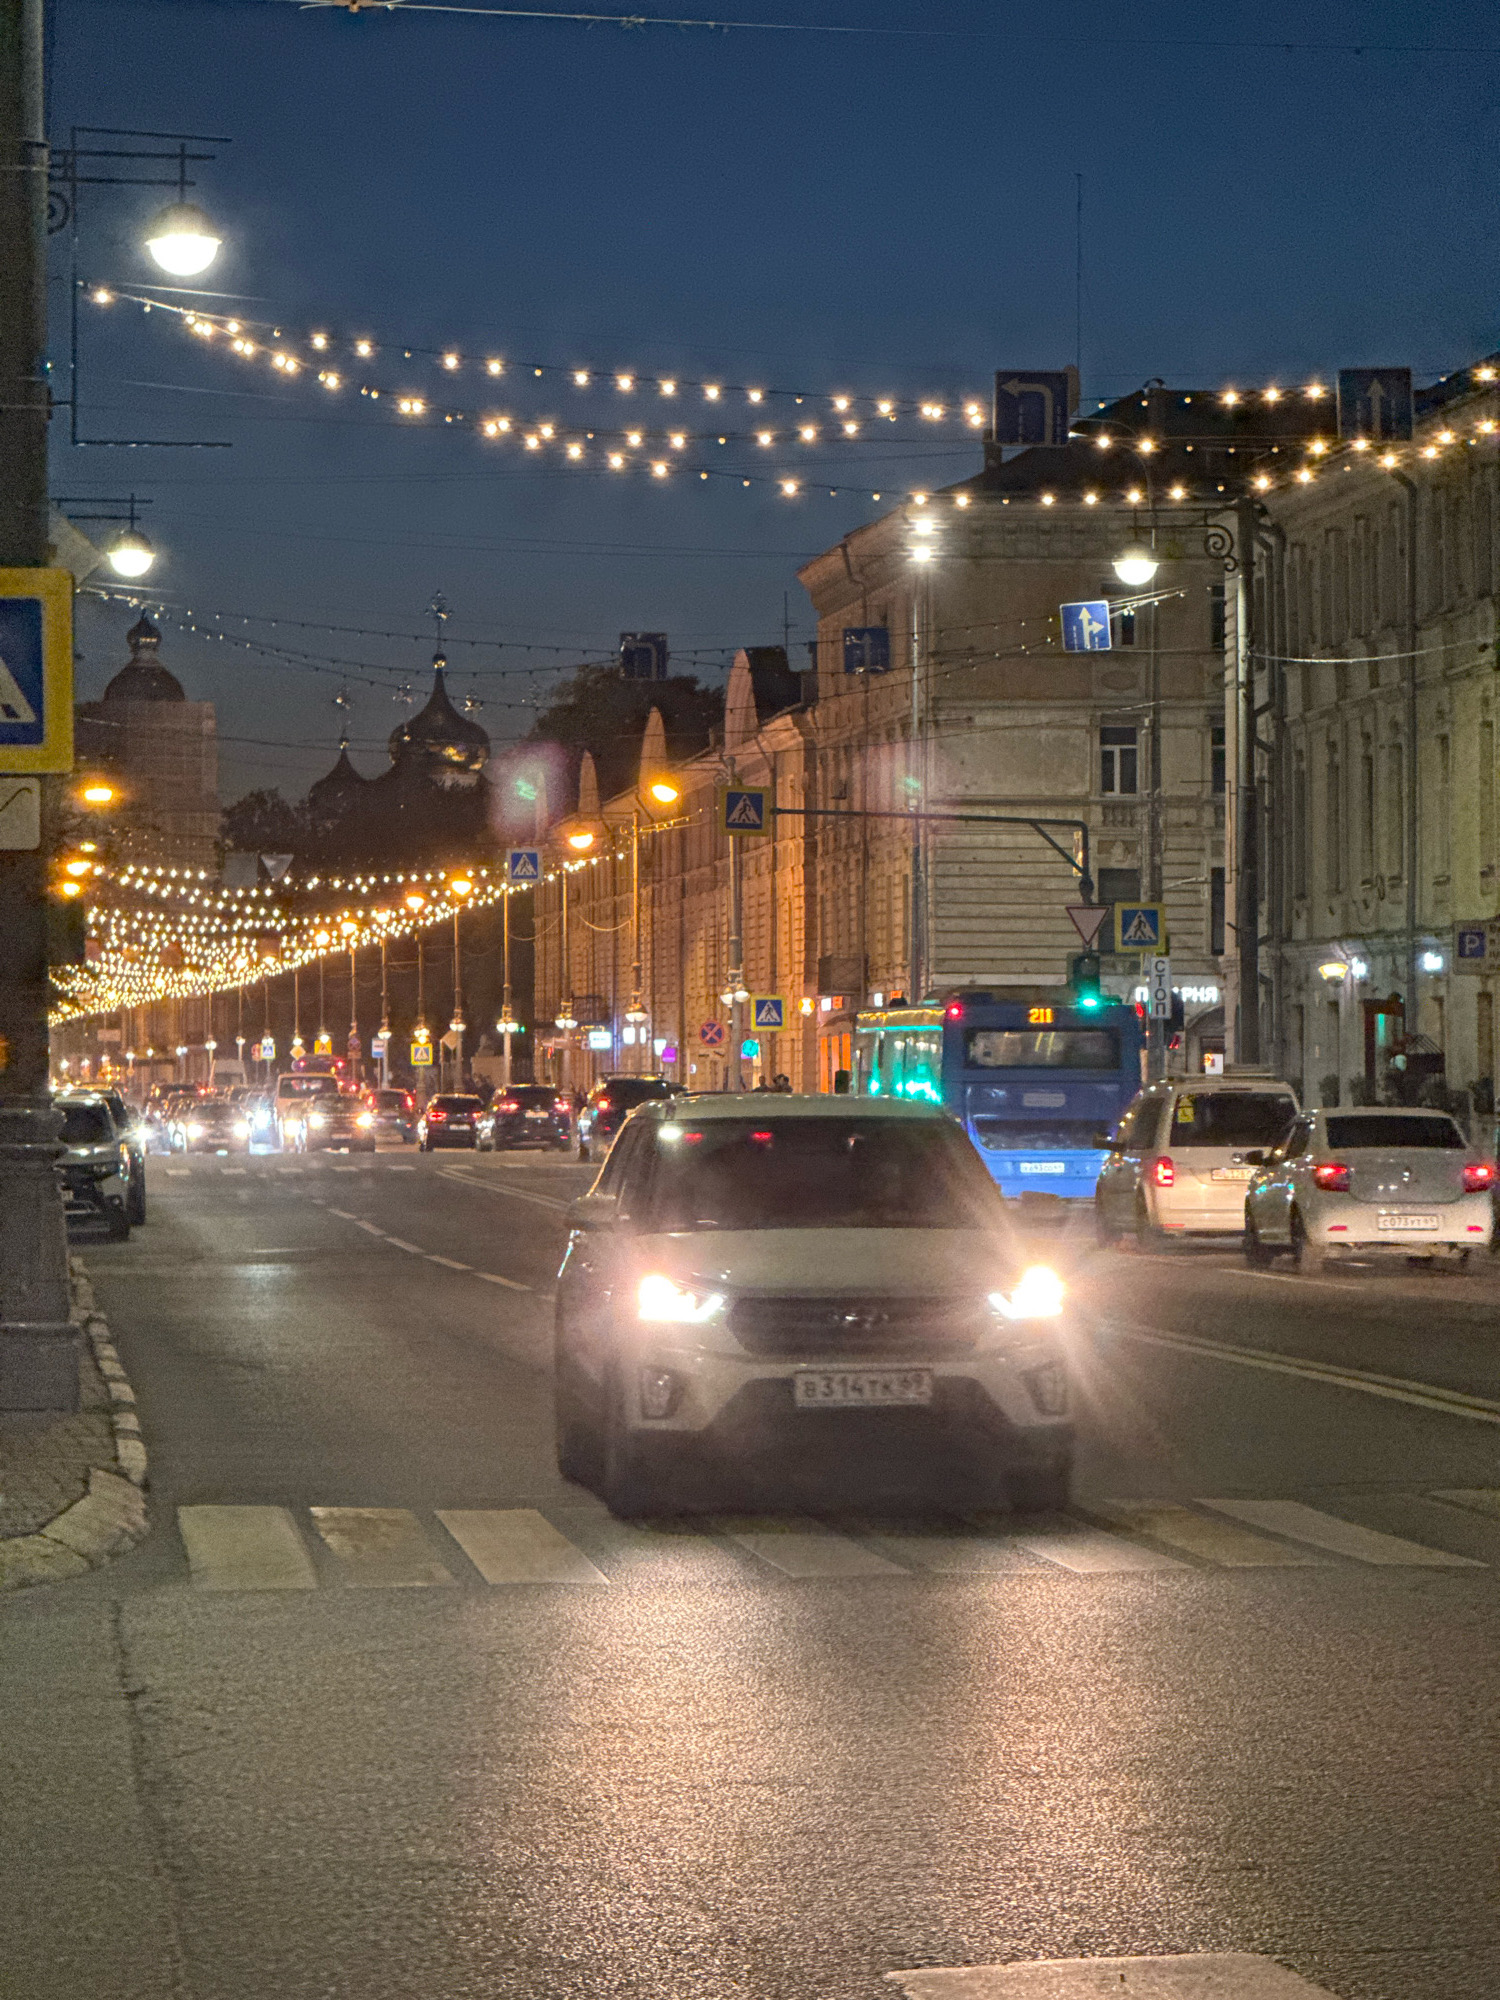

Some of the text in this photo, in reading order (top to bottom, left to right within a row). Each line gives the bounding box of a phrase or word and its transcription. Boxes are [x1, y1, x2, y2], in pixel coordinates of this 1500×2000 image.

[1134, 986, 1218, 1002] ПРНЯ
[1154, 960, 1167, 1015] СТОП
[1028, 1007, 1053, 1024] 211
